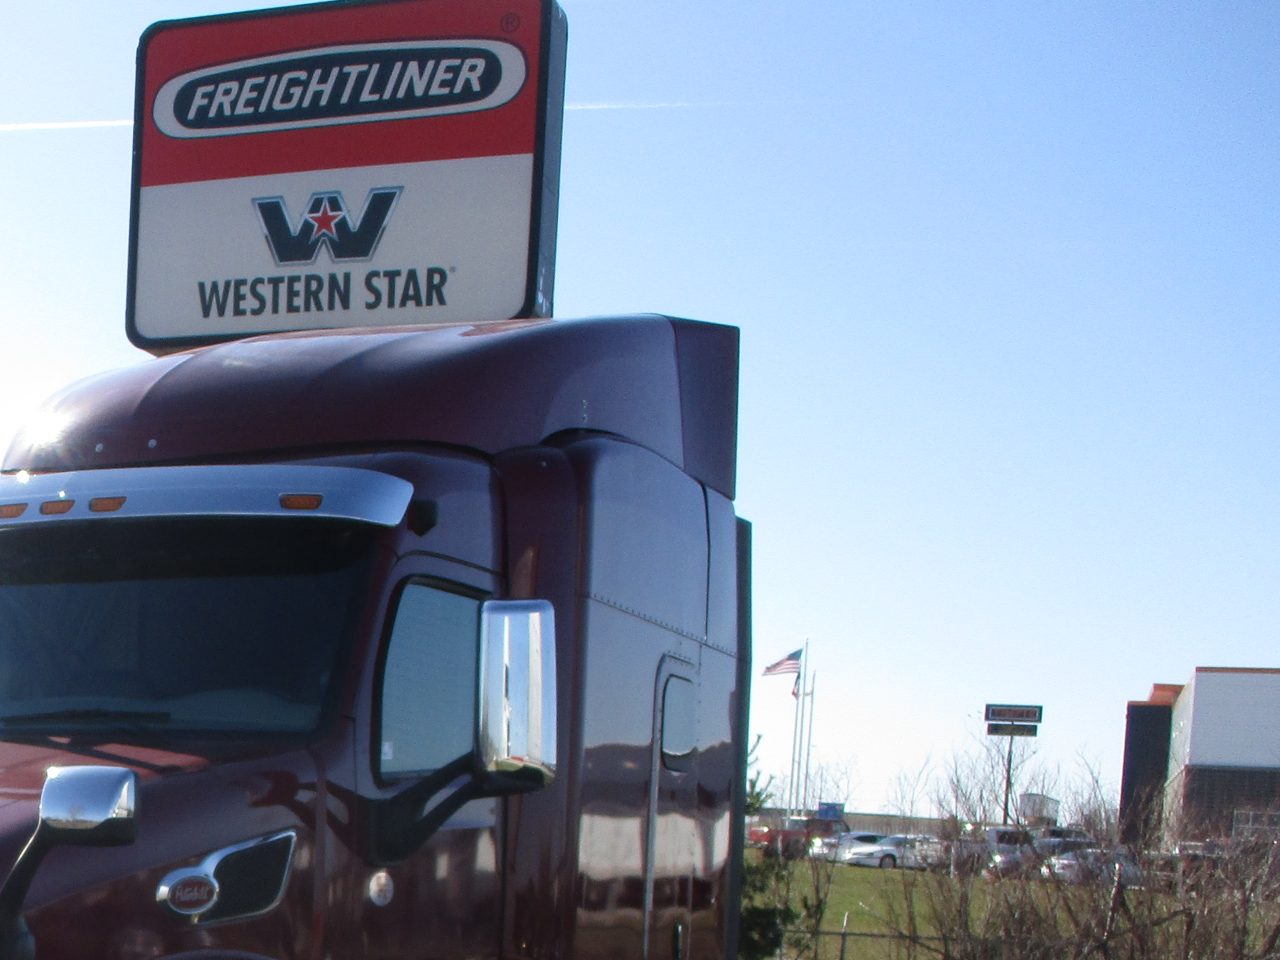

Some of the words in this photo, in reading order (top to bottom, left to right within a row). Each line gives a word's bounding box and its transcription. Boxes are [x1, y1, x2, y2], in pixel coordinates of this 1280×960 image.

[186, 57, 486, 121] FREIGHTLINER
[197, 271, 352, 318] WESTERN
[364, 267, 448, 310] STAR
